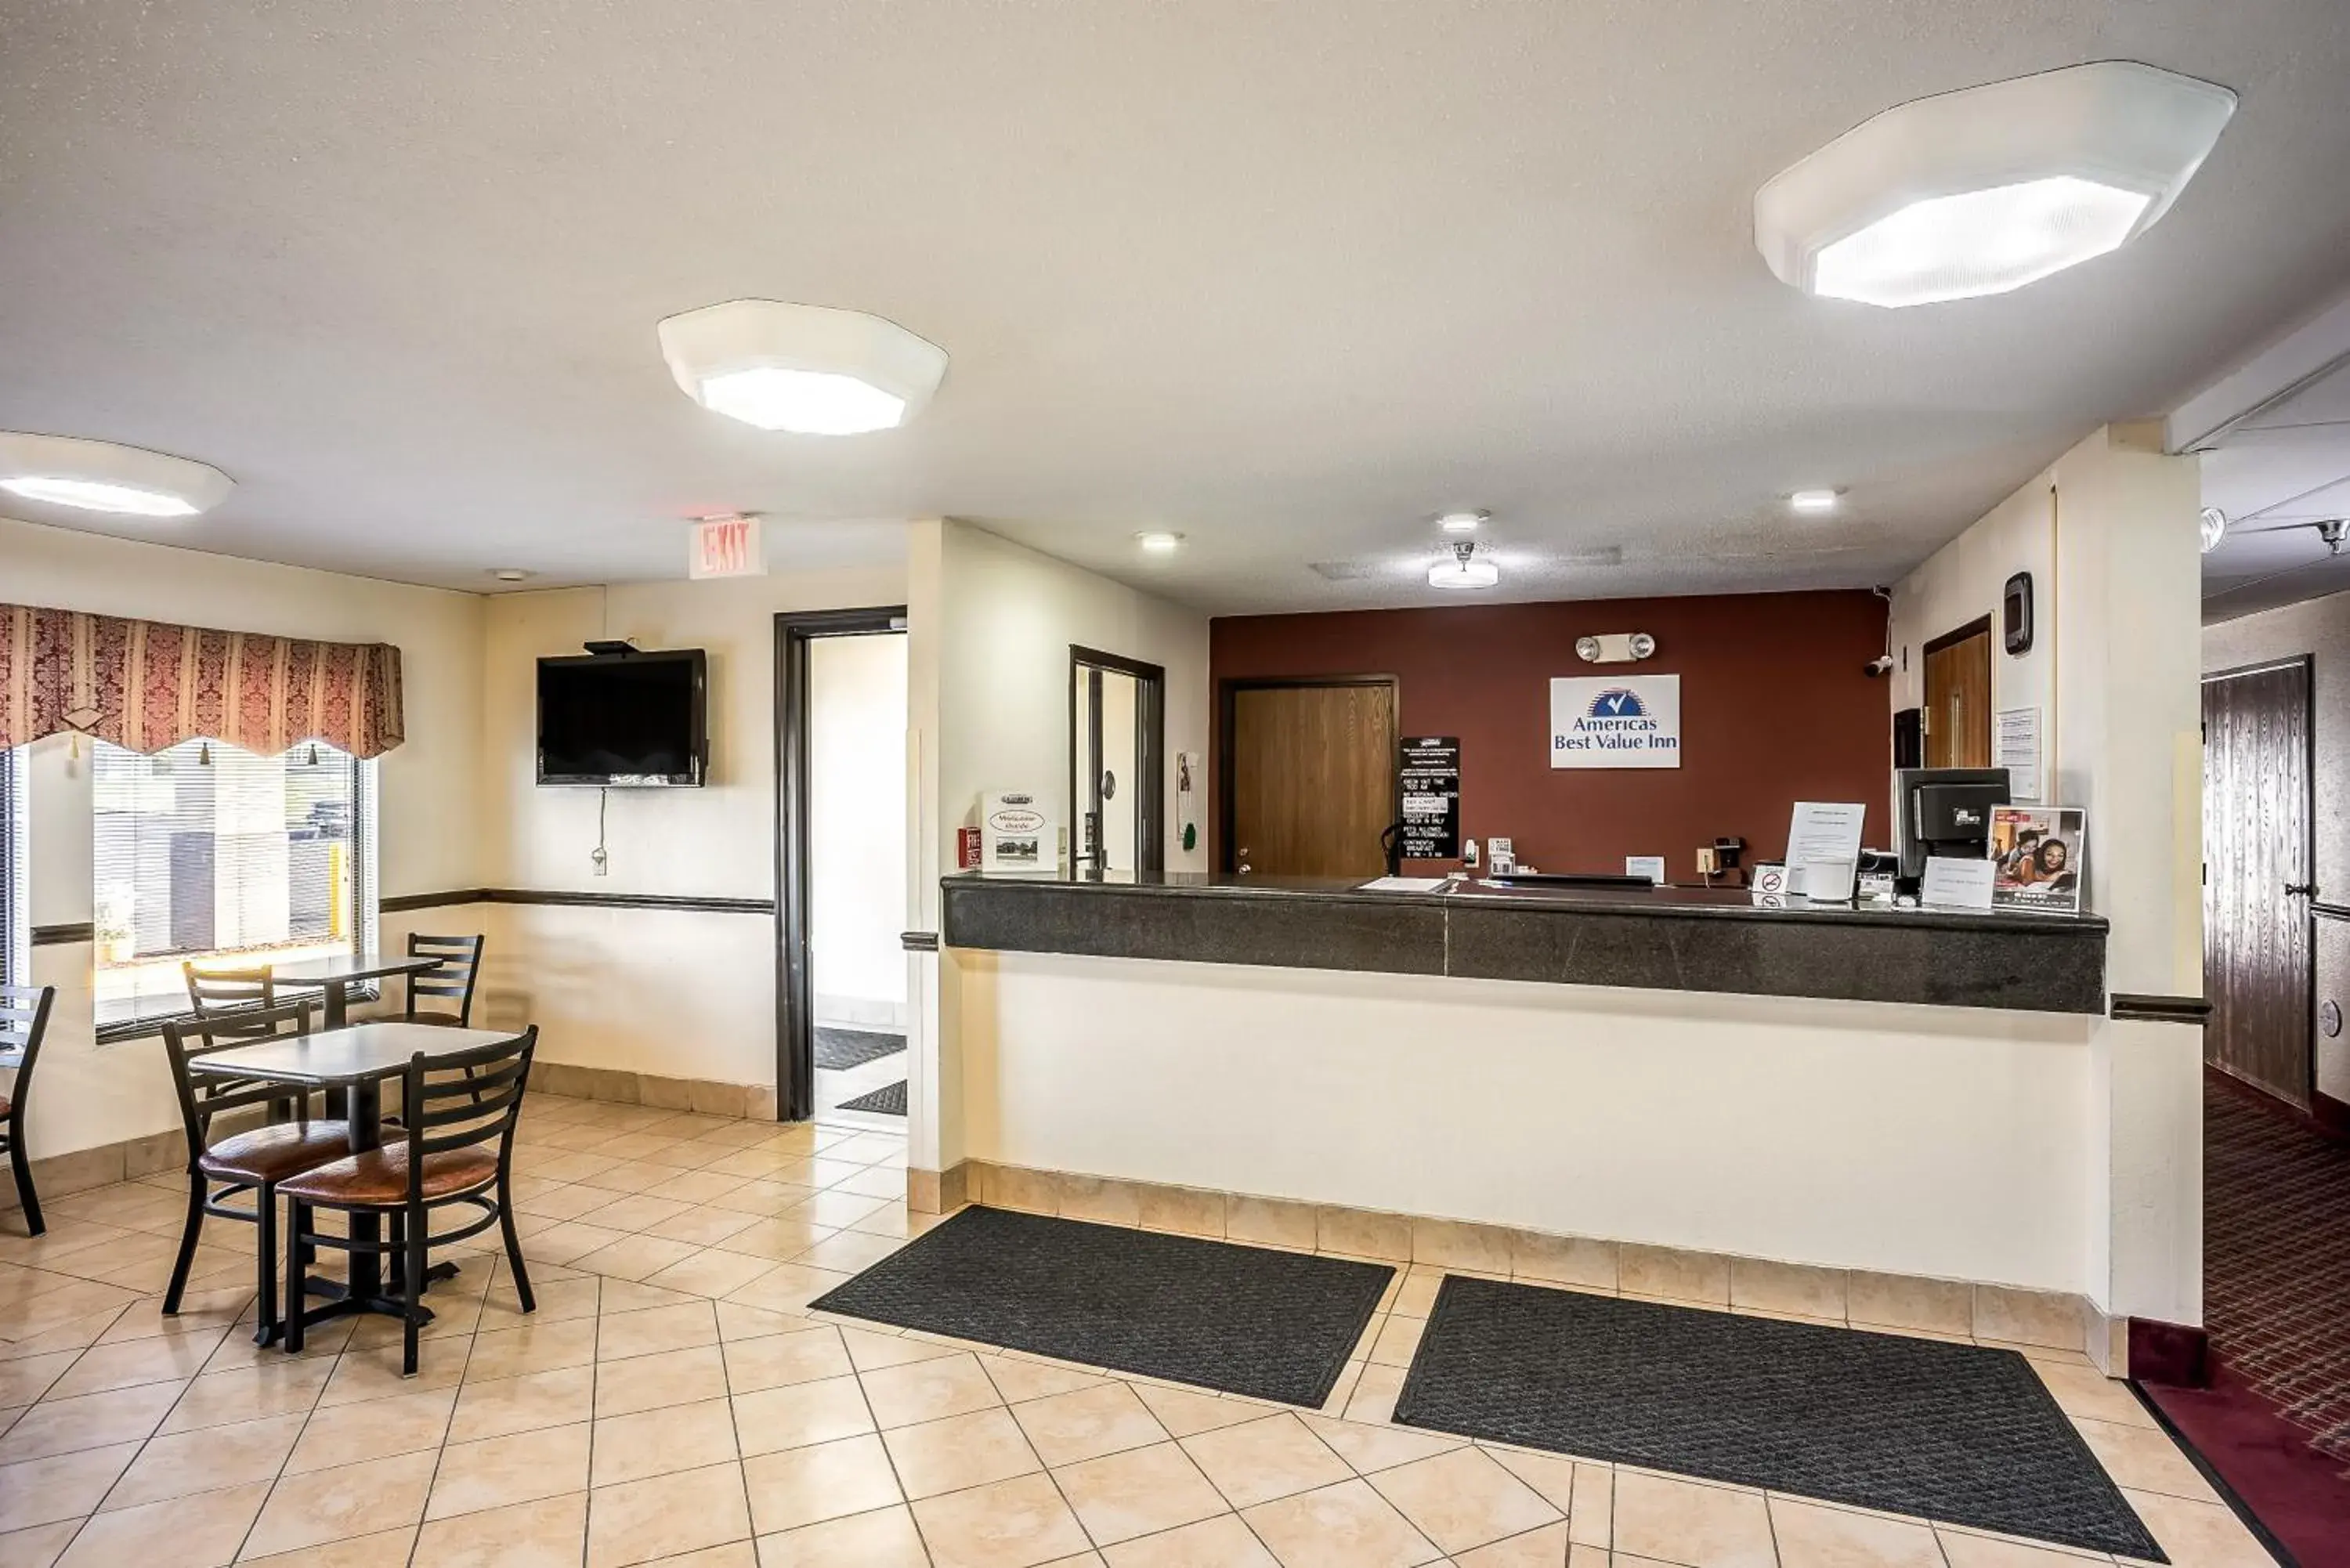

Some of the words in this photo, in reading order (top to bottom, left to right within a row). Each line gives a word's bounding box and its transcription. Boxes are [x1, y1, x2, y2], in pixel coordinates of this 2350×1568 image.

[703, 522, 750, 573] EXIT
[1573, 717, 1658, 732] Americas
[1554, 735, 1591, 750] Best
[1596, 734, 1643, 750] Value
[1649, 735, 1677, 749] Inn
